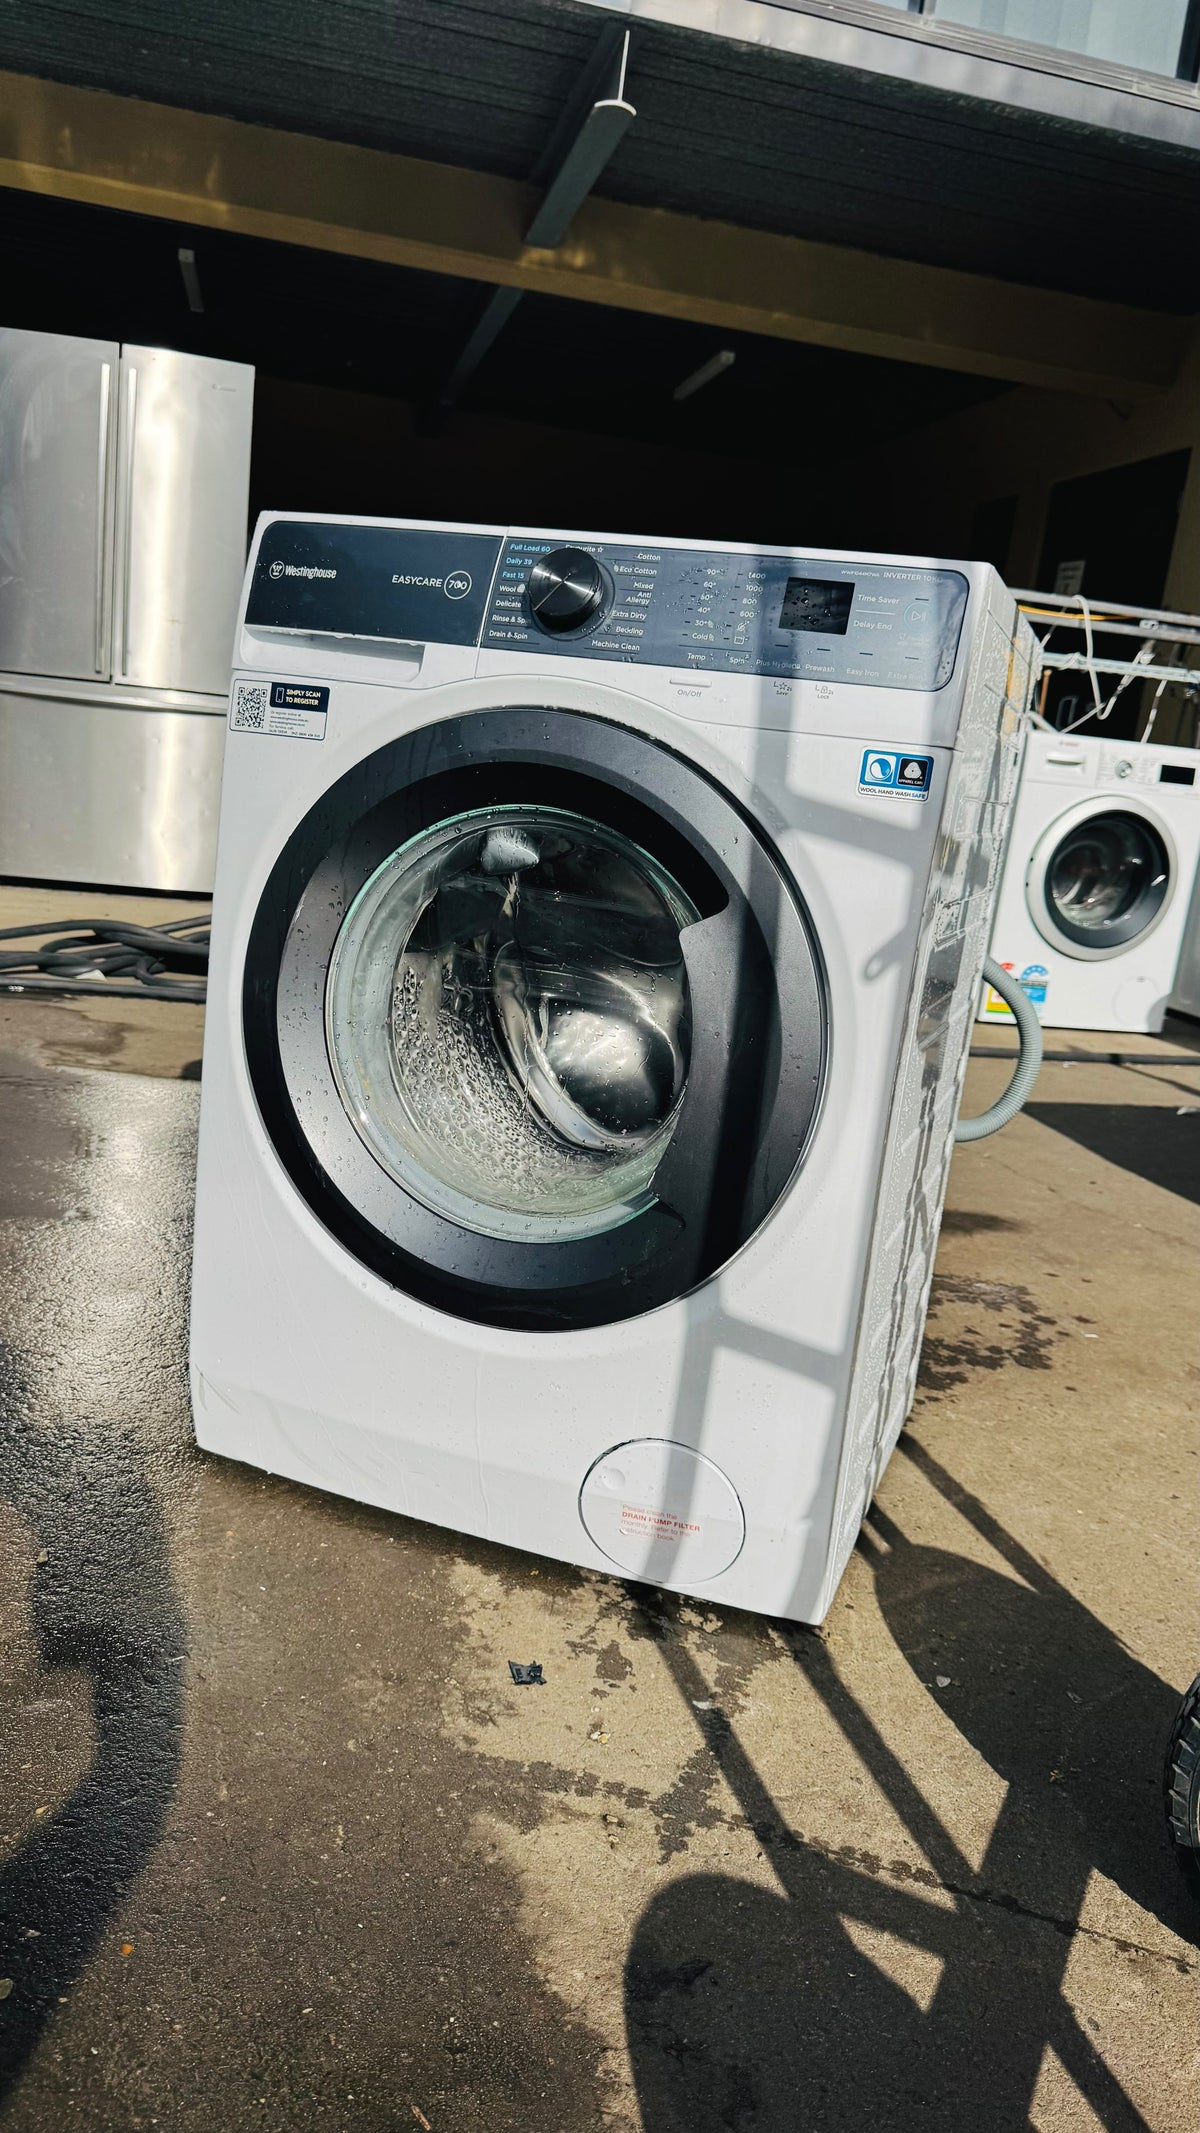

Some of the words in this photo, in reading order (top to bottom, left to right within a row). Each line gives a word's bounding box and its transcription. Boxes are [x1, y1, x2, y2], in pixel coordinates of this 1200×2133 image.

[524, 544, 540, 552] Load
[638, 553, 661, 561] Cotton
[285, 566, 337, 580] Westinghouse
[634, 567, 657, 575] Cotton
[884, 572, 921, 581] INVERTER
[392, 575, 443, 588] EASYCARE
[633, 582, 654, 590] Mixed
[496, 600, 522, 608] Delicate
[626, 597, 650, 605] Allergy
[879, 596, 900, 604] Saver
[631, 612, 647, 620] Dirty
[854, 620, 876, 630] Delay
[878, 623, 893, 631] End
[616, 626, 644, 636] Bedding
[514, 632, 528, 640] Spin
[592, 640, 620, 649] Machine
[621, 643, 640, 651] Clean
[688, 653, 706, 661] Temp
[729, 657, 745, 665] Spin
[806, 664, 835, 673] Prewash
[847, 668, 864, 676] Easy
[286, 689, 305, 697] SIMPLY
[306, 690, 321, 698] SCAN
[678, 689, 702, 697] On/Off
[294, 697, 319, 706] REGISTER
[622, 1512, 647, 1522] DRAIN
[674, 1522, 701, 1532] FILTER
